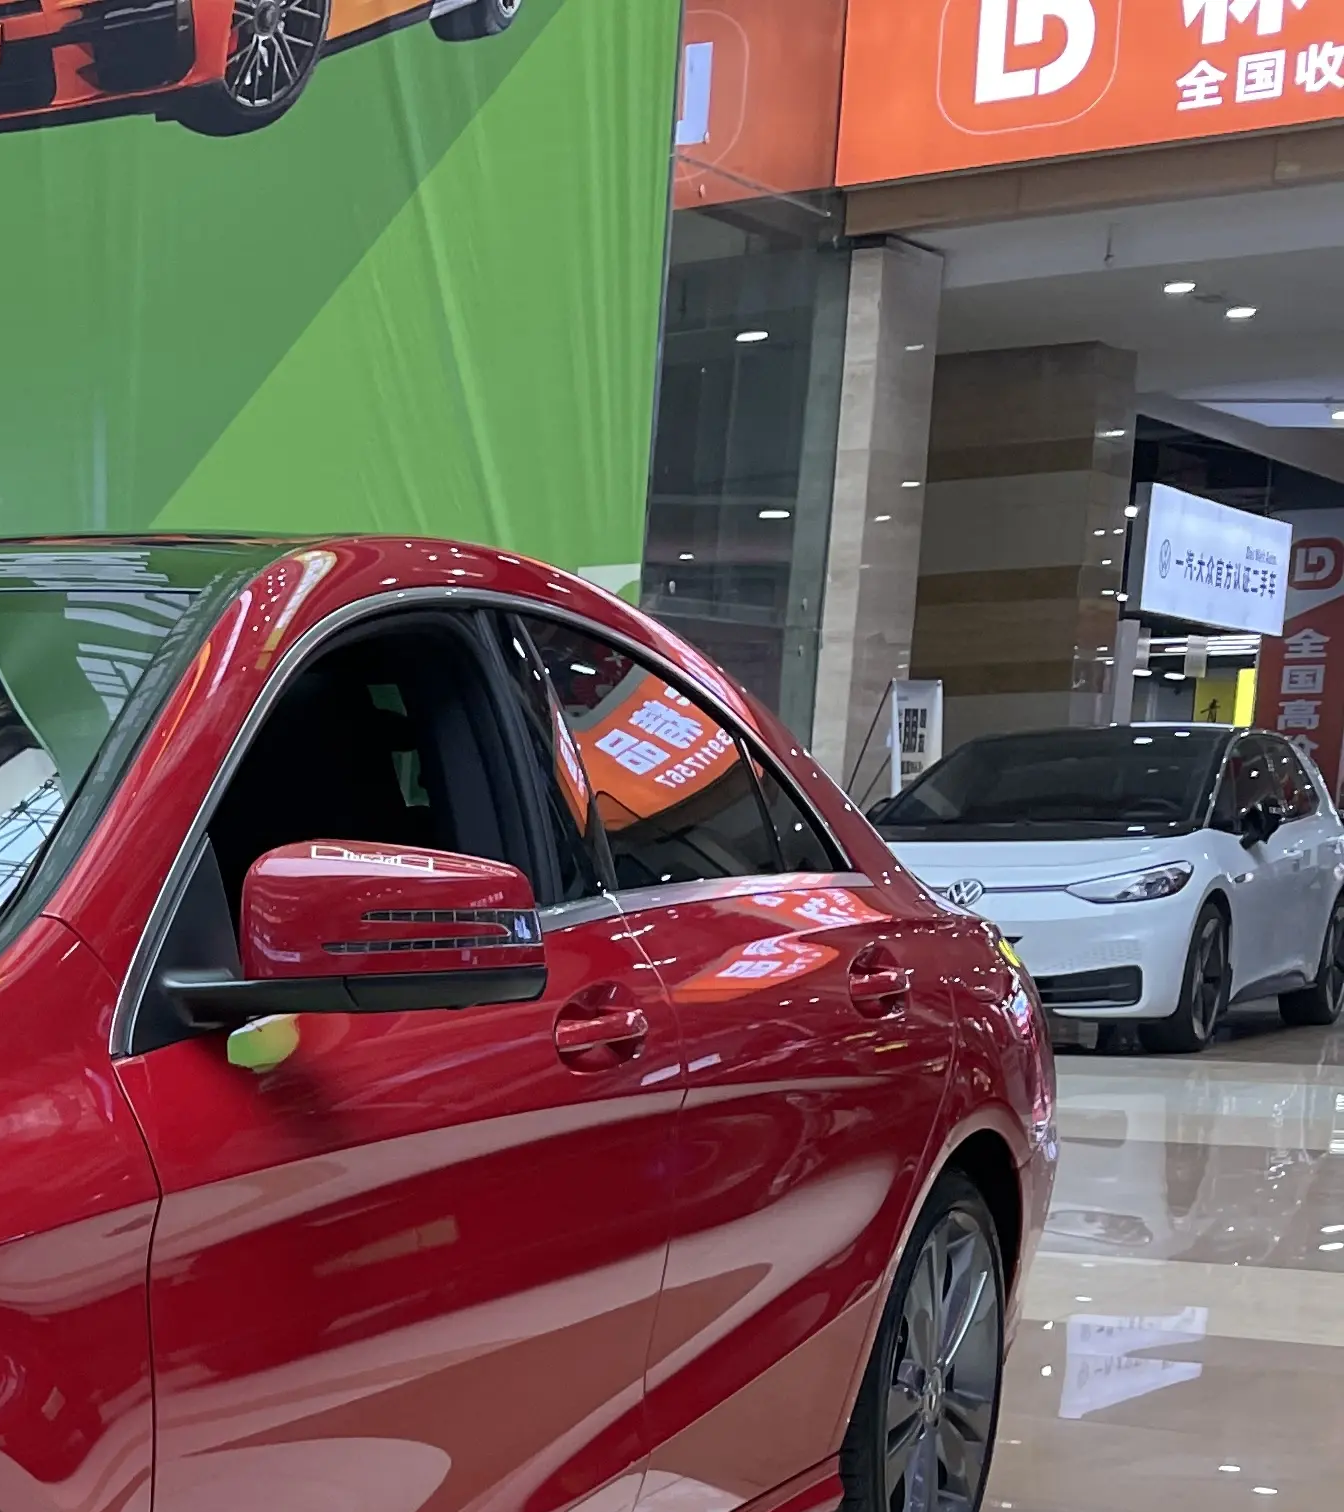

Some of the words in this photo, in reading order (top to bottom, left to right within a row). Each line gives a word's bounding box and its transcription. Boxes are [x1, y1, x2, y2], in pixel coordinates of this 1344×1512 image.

[1176, 40, 1344, 111] 全国收
[1175, 548, 1277, 600] 一汽-大众官方认证二手车
